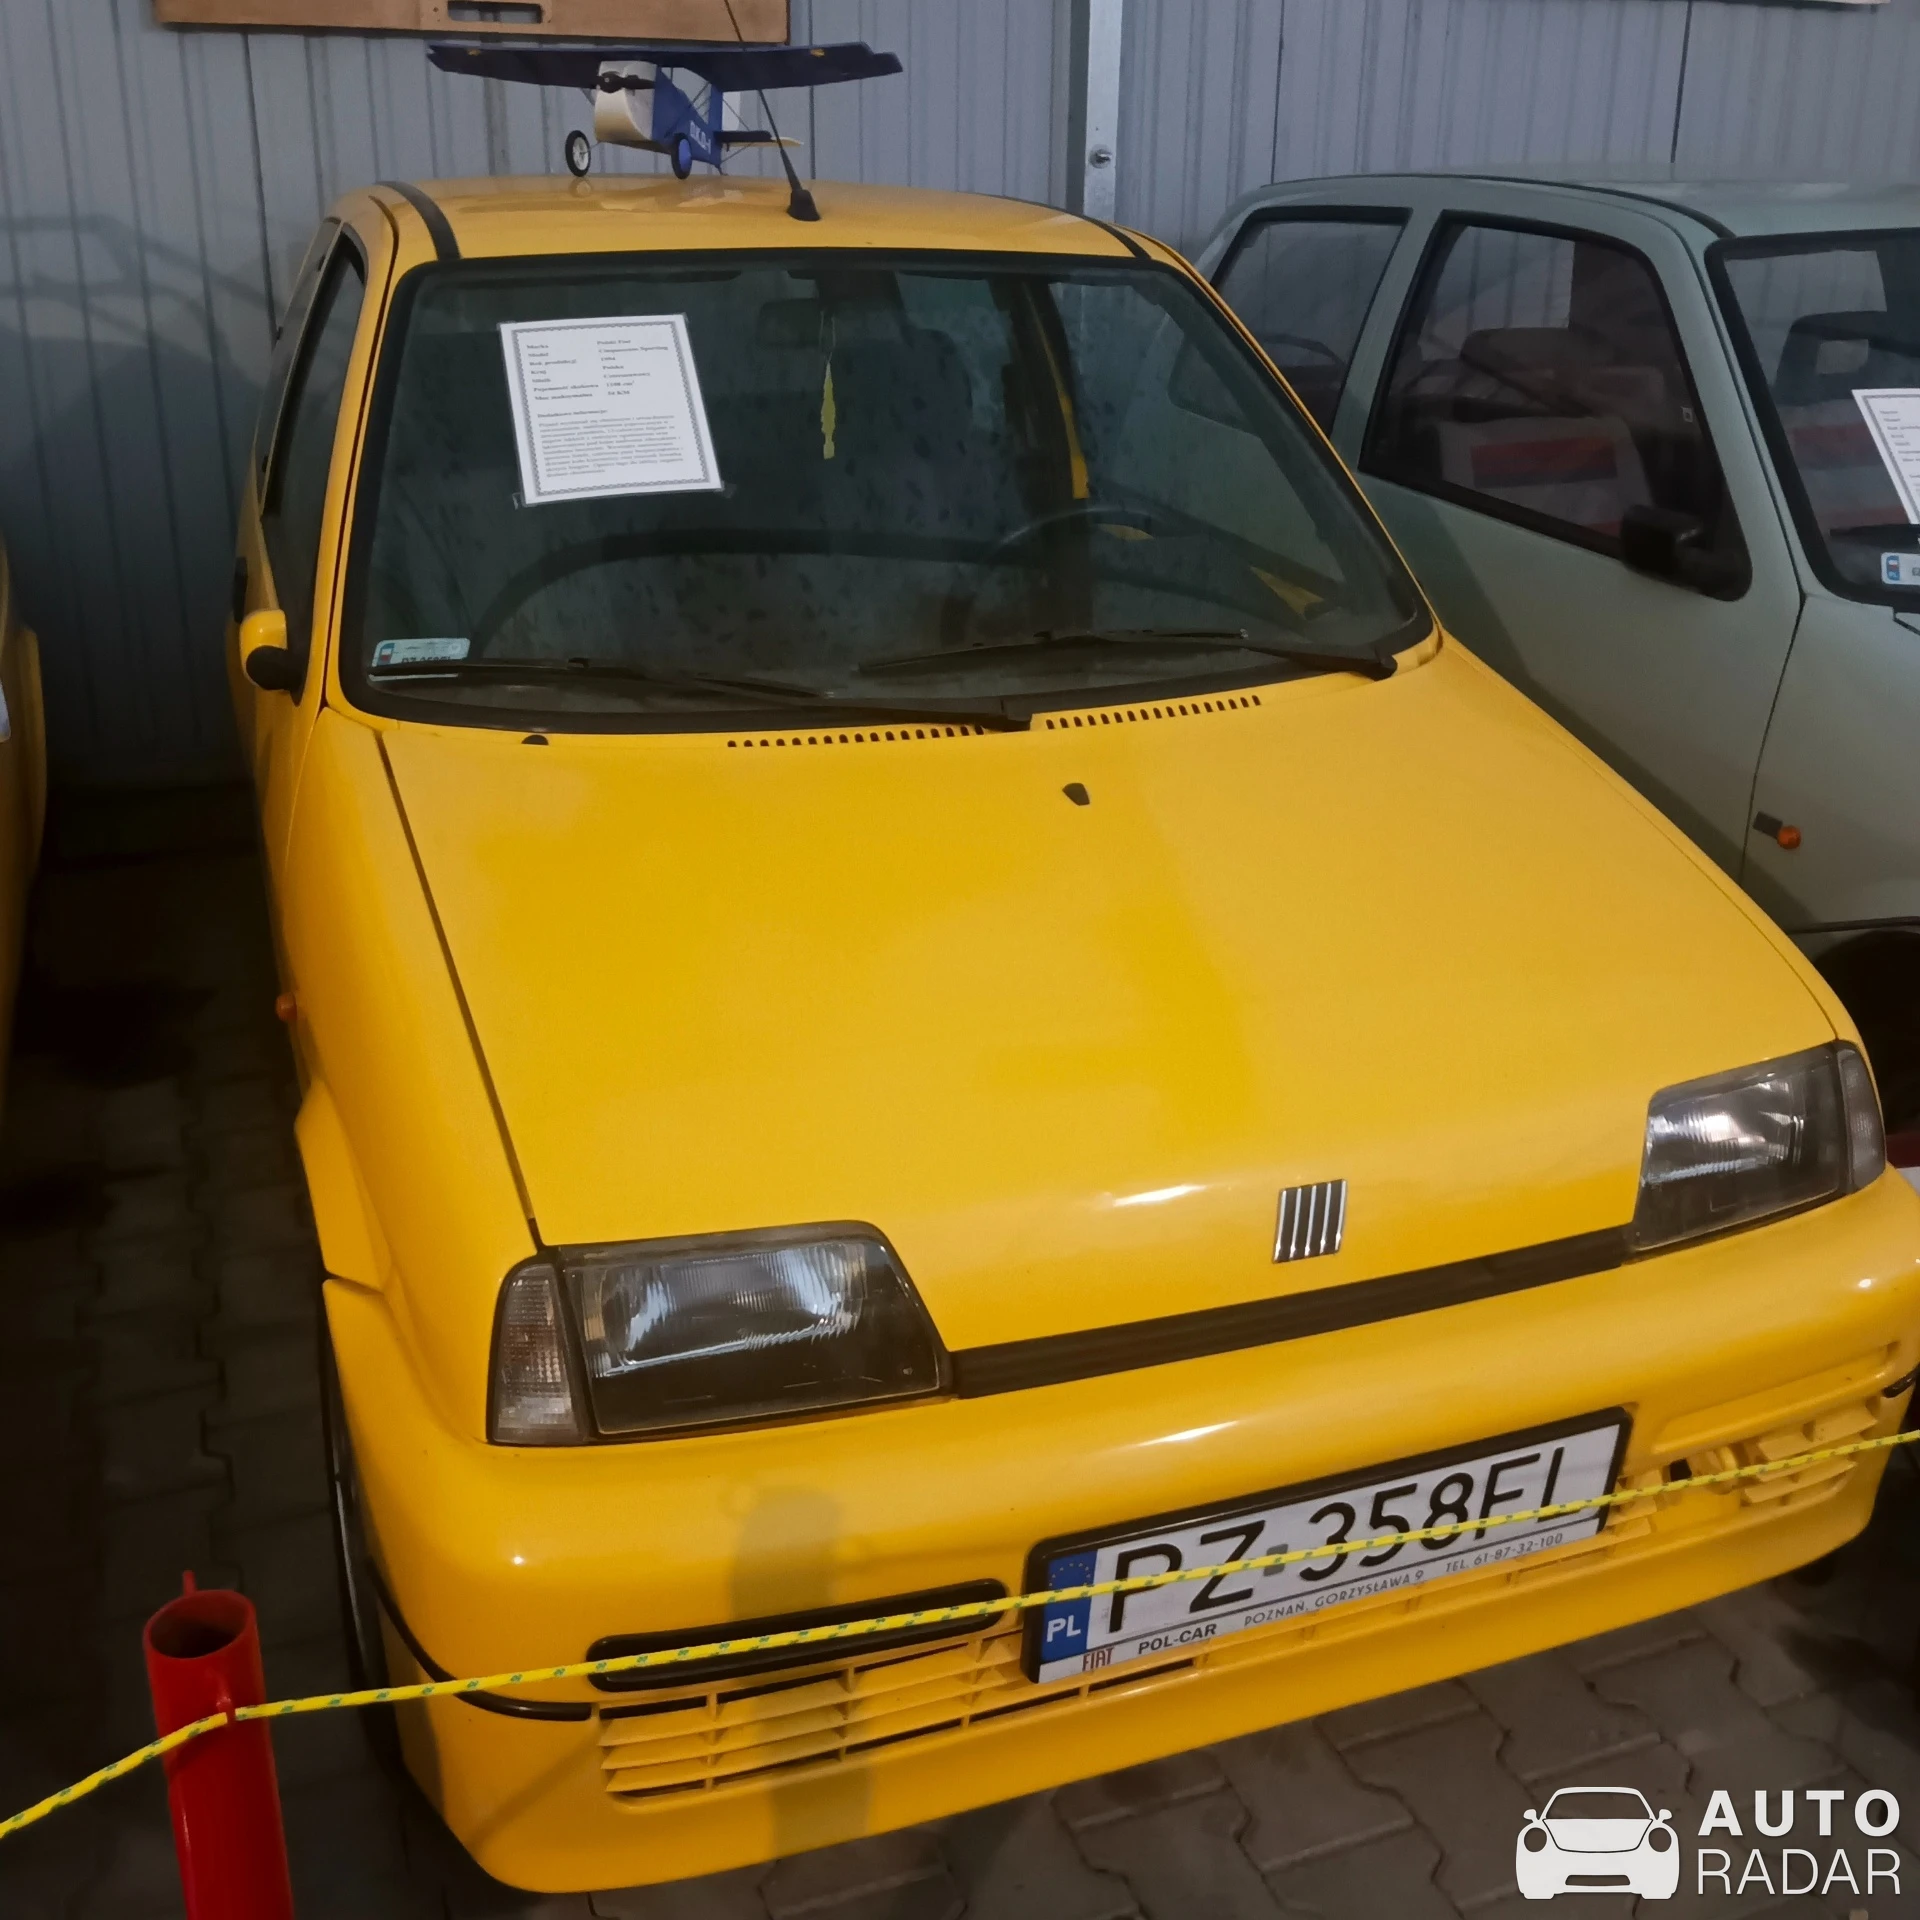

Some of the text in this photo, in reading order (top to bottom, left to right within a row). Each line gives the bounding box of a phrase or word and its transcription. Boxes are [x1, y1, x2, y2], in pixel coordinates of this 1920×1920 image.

[1082, 1647, 1115, 1672] FIAT
[1138, 1623, 1218, 1655] POL-CAR
[1414, 1569, 1425, 1581] 9
[1473, 1533, 1564, 1566] 61-87-32-100
[1109, 1446, 1581, 1633] PZ 358FL
[1046, 1614, 1081, 1643] PL
